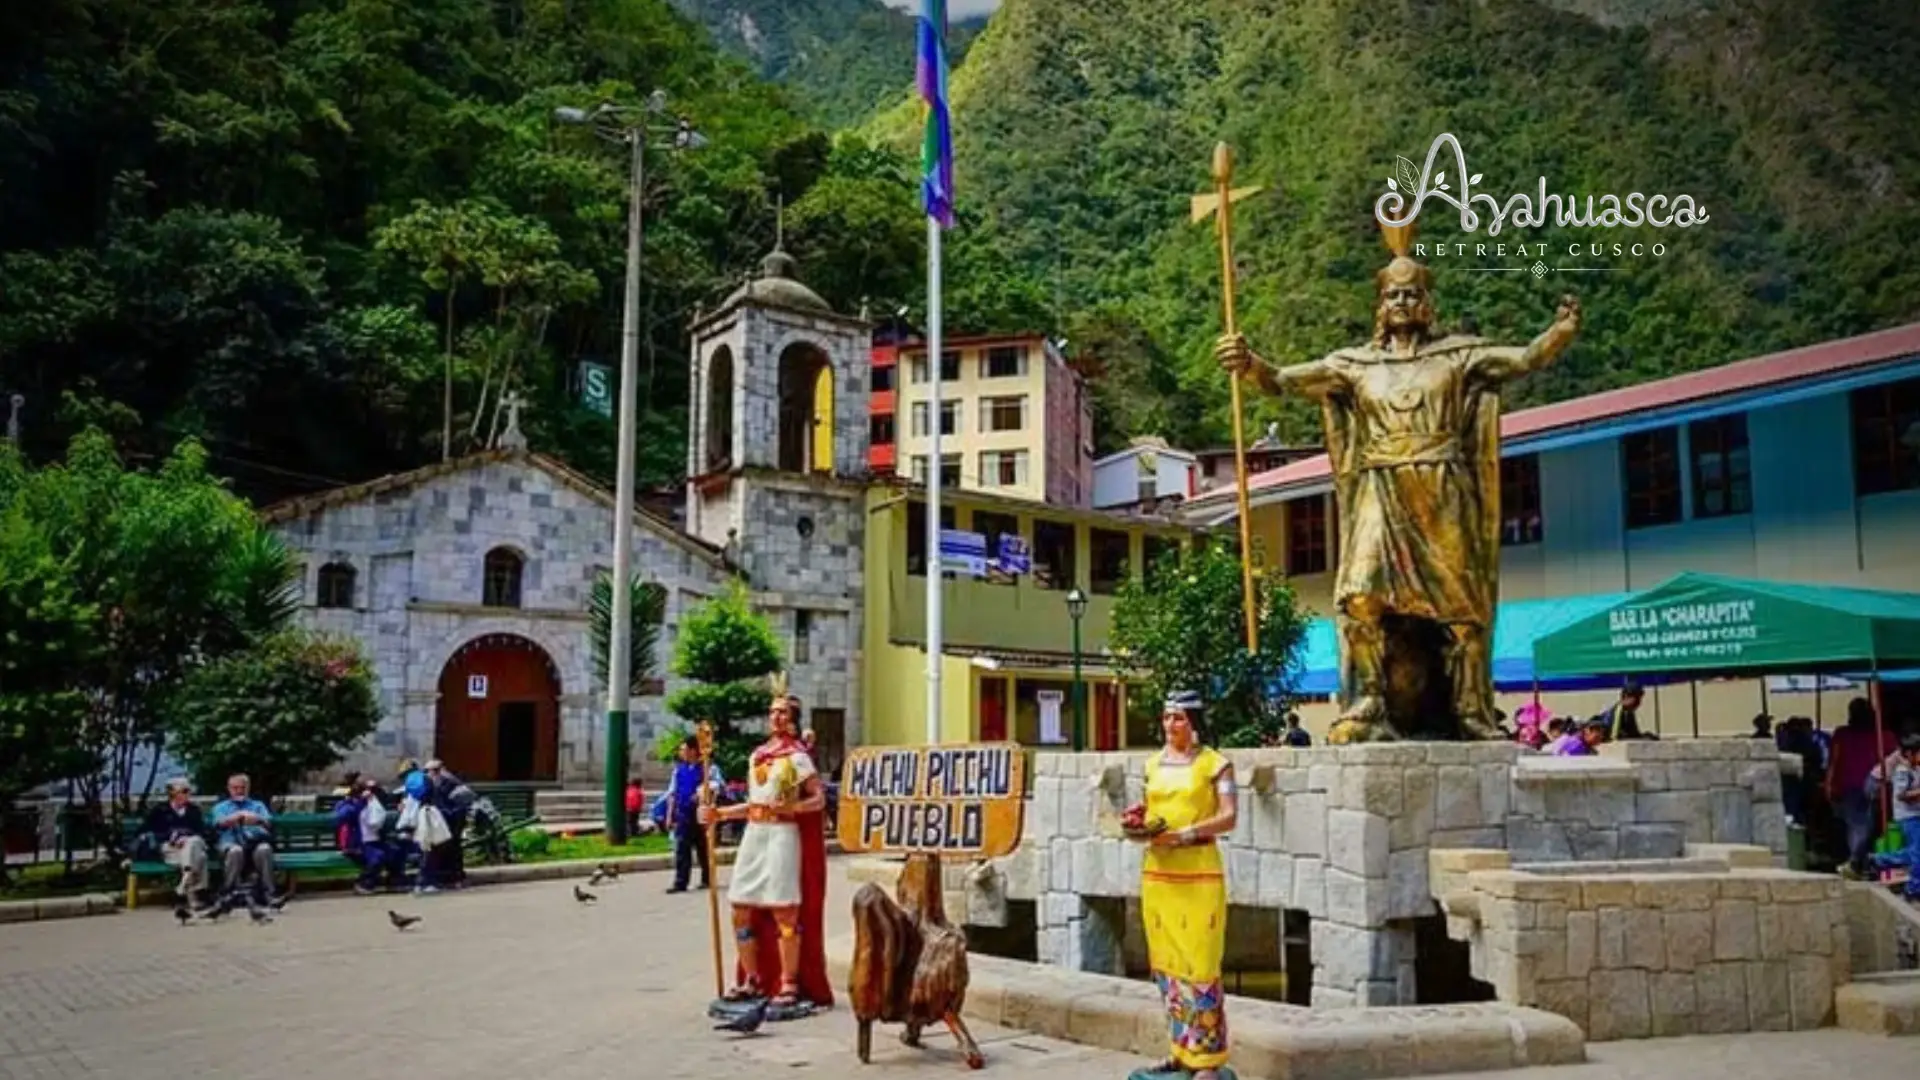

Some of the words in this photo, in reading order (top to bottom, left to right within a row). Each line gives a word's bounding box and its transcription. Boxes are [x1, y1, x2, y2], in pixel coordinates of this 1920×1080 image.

[587, 368, 607, 399] S
[850, 750, 919, 797] MACHU
[926, 748, 1012, 797] PICCHU
[863, 801, 985, 849] PUEBLO
